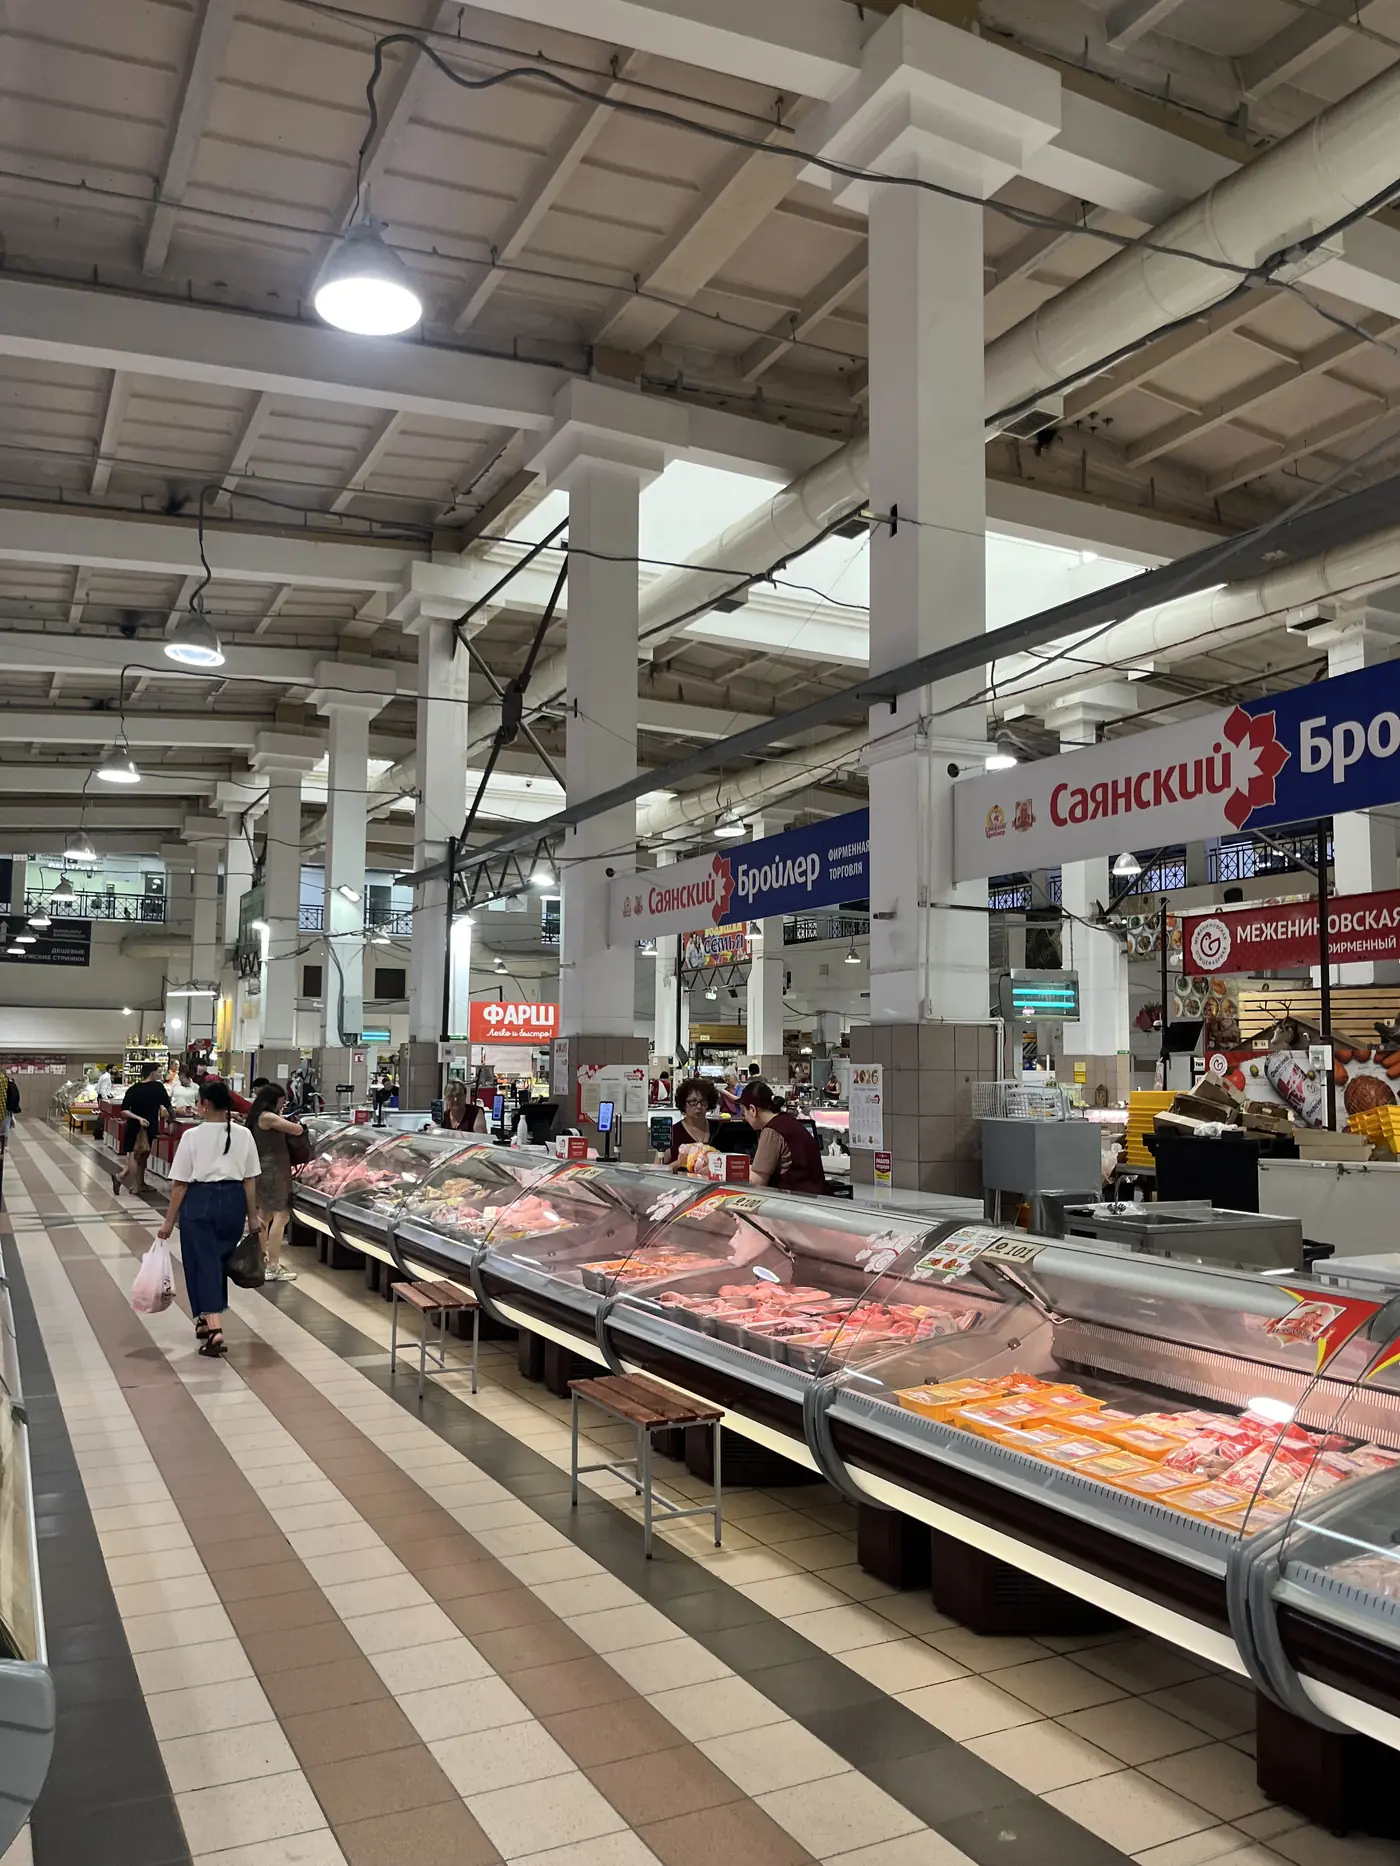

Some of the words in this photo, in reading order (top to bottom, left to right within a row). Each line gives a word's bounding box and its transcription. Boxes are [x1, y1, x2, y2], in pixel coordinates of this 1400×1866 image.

[1049, 742, 1232, 827] Саянский
[1300, 711, 1400, 784] Бро
[829, 861, 863, 880] ТОРГОВЛЯ
[648, 874, 716, 915] Саянский
[737, 854, 820, 903] Бройлер
[483, 1004, 554, 1025] ФАРШ
[487, 1028, 511, 1037] Легко
[519, 1029, 552, 1039] быстро!
[853, 1069, 878, 1084] 2026
[1003, 1243, 1035, 1259] 101
